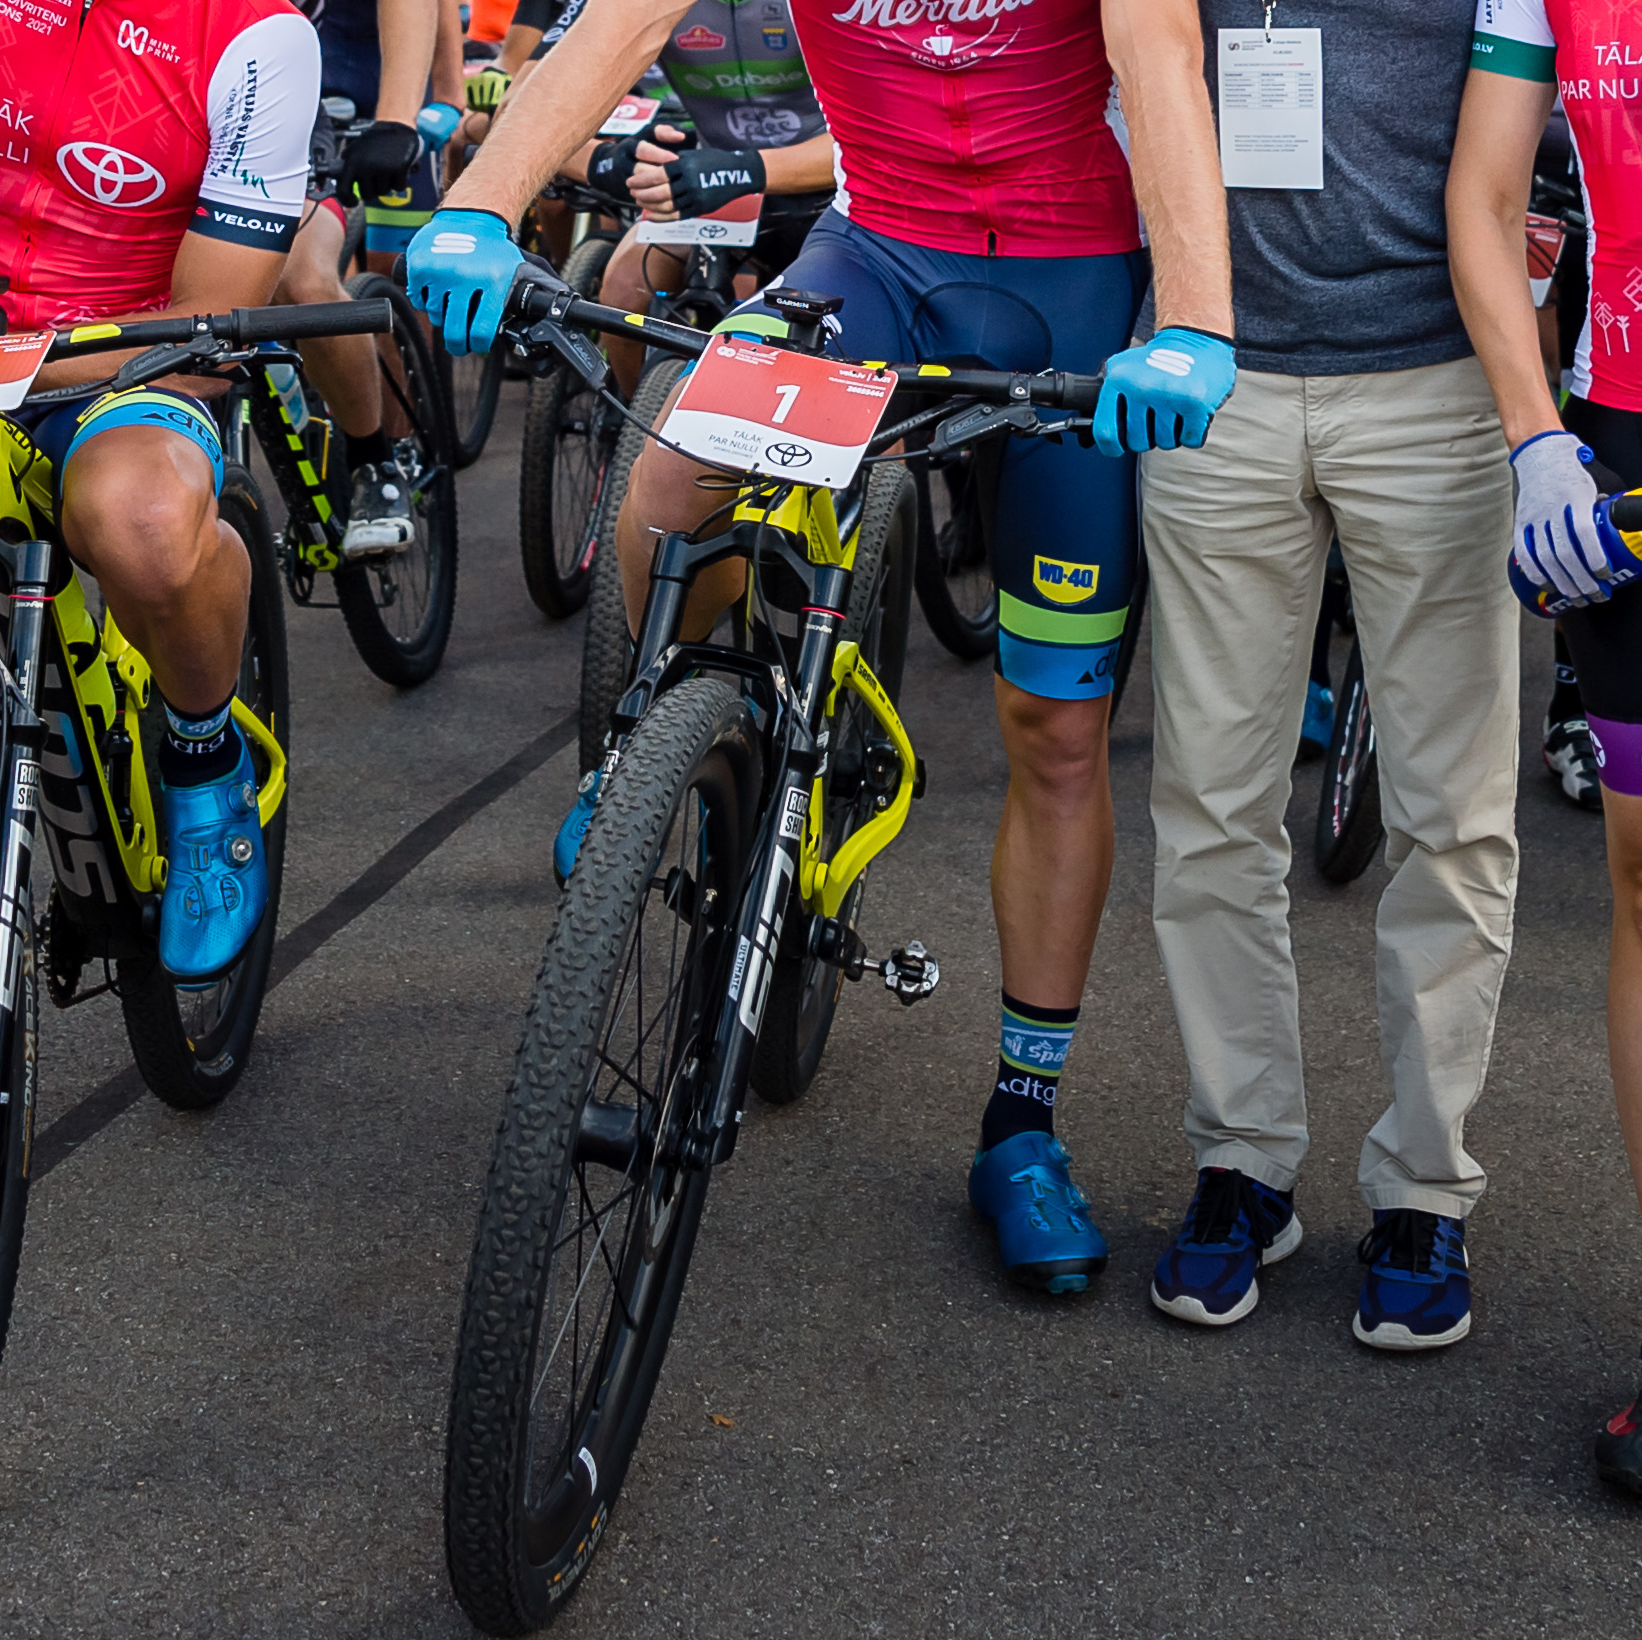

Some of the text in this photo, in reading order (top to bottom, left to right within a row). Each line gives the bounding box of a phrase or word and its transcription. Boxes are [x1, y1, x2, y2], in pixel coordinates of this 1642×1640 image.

[25, 16, 53, 36] 2021
[145, 45, 182, 64] PRINT
[148, 38, 178, 53] MINT
[1561, 78, 1592, 102] PAR
[699, 169, 753, 189] LATVIA
[213, 210, 286, 235] VELO.LV
[776, 297, 810, 310] GARMIN
[770, 384, 802, 425] 1
[708, 433, 760, 454] PAR NULLI
[1038, 560, 1094, 589] WD-40
[857, 663, 878, 693] SRAM
[731, 943, 748, 991] ULTIMATE
